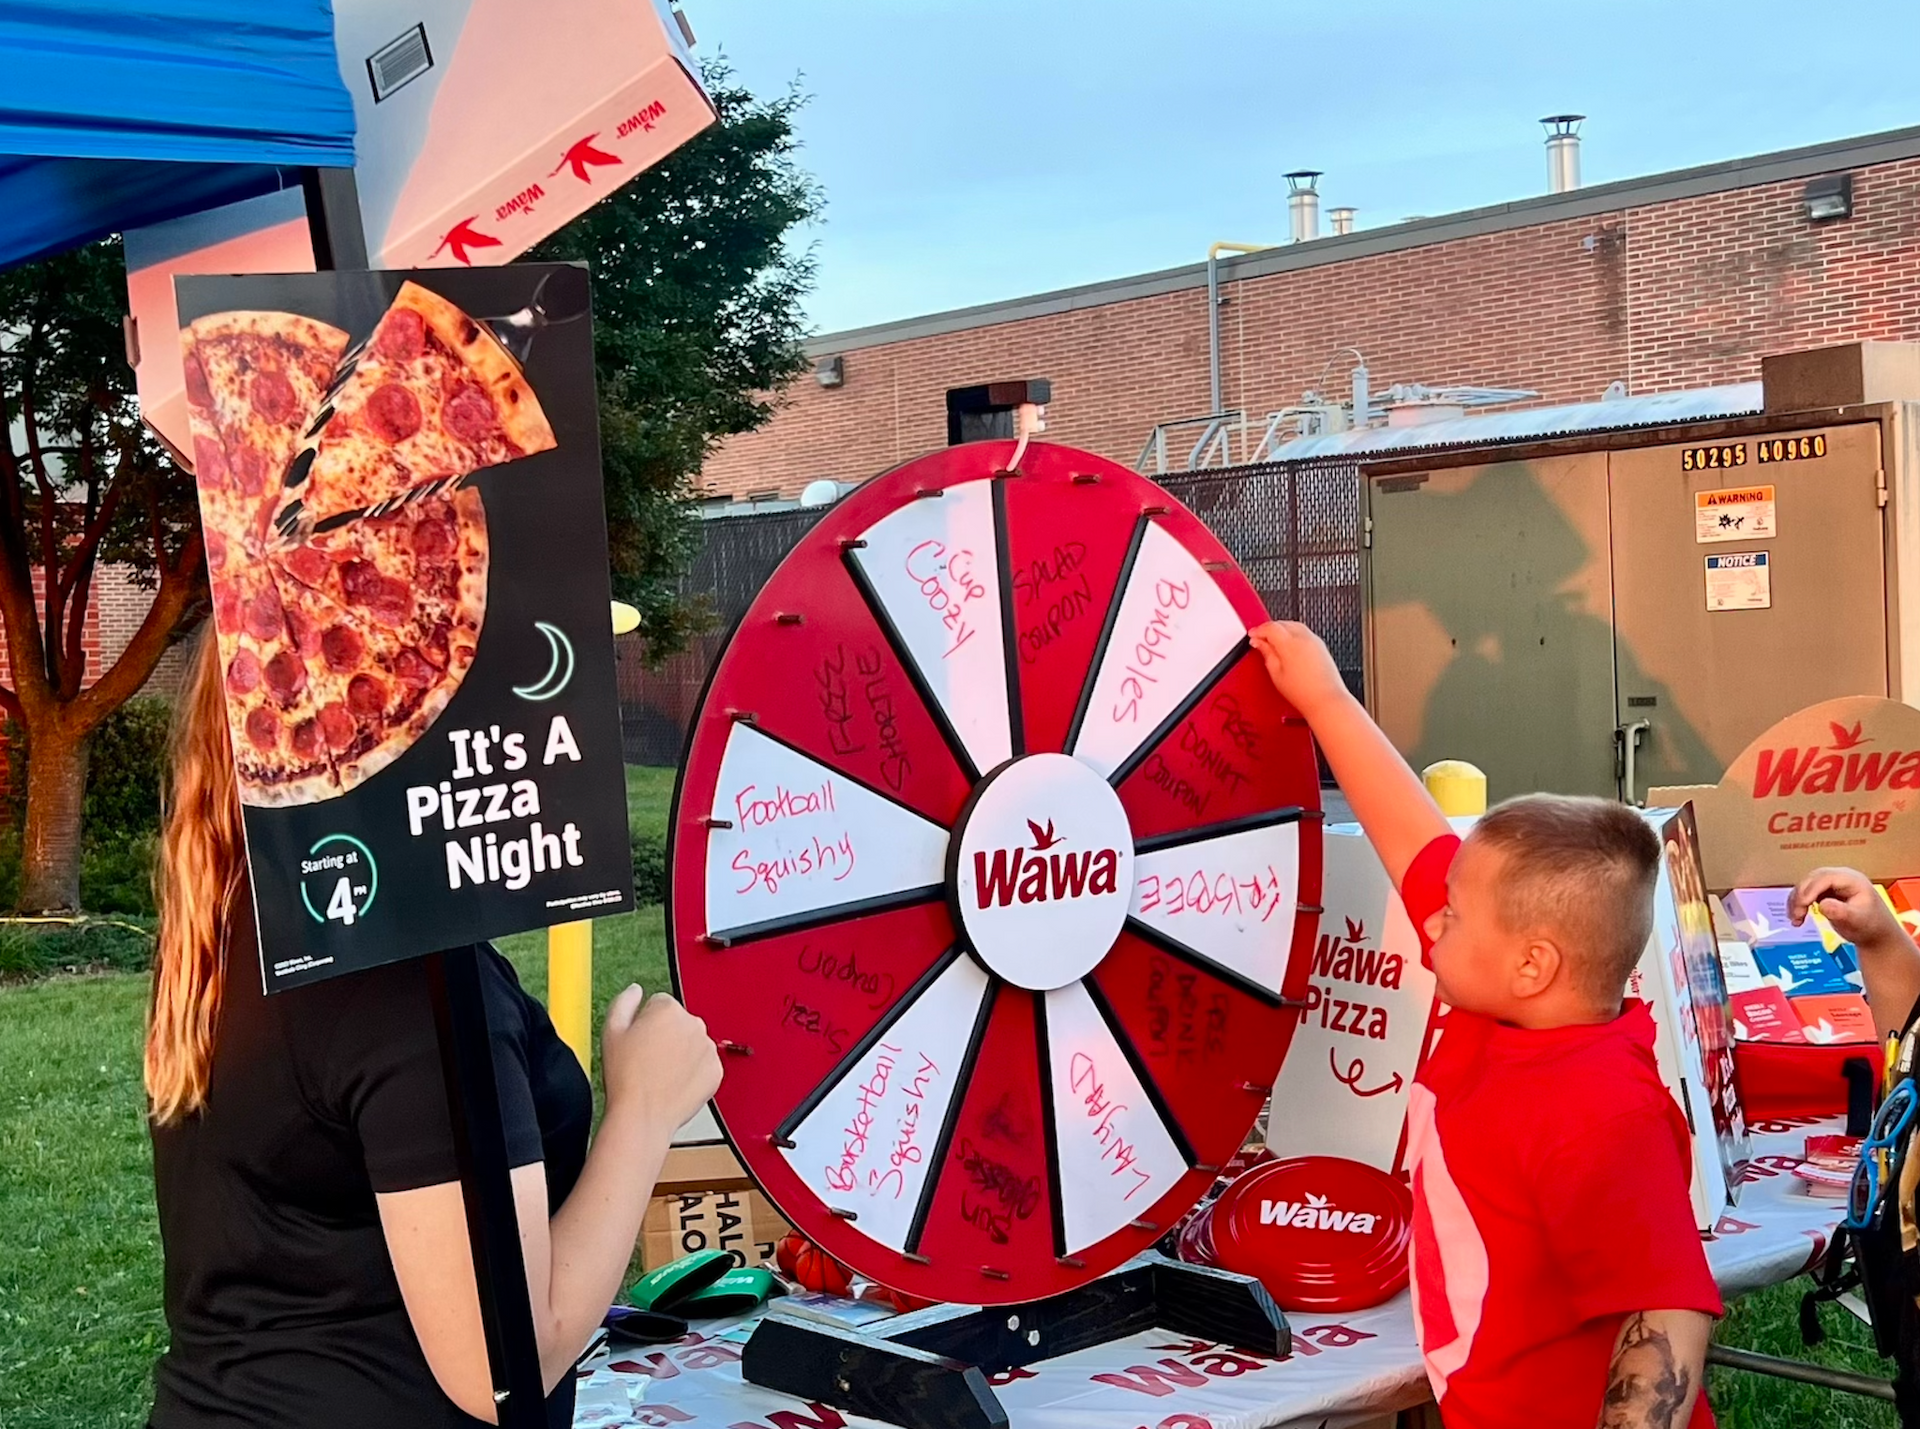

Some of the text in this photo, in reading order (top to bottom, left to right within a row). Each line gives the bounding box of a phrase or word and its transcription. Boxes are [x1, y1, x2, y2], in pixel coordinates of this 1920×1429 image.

[617, 100, 667, 138] Wawa
[496, 183, 546, 220] Wawa
[1683, 435, 1825, 470] 50295 40960
[1717, 491, 1763, 505] WARNING
[1012, 541, 1087, 607] SALAD
[1717, 554, 1757, 568] NOTICE
[448, 715, 582, 780] It's A
[1752, 746, 1920, 800] Wawa
[406, 779, 541, 836] Pizza
[735, 779, 835, 833] Football
[1767, 806, 1892, 834] Catering
[301, 851, 359, 875] Starting at
[445, 822, 584, 890] Night
[731, 832, 856, 894] Squishy
[973, 847, 1118, 910] Wawa
[326, 876, 357, 926] 4
[1311, 933, 1403, 990] Wawa
[1301, 984, 1388, 1040] Pizza
[1259, 1199, 1378, 1234] Wawa
